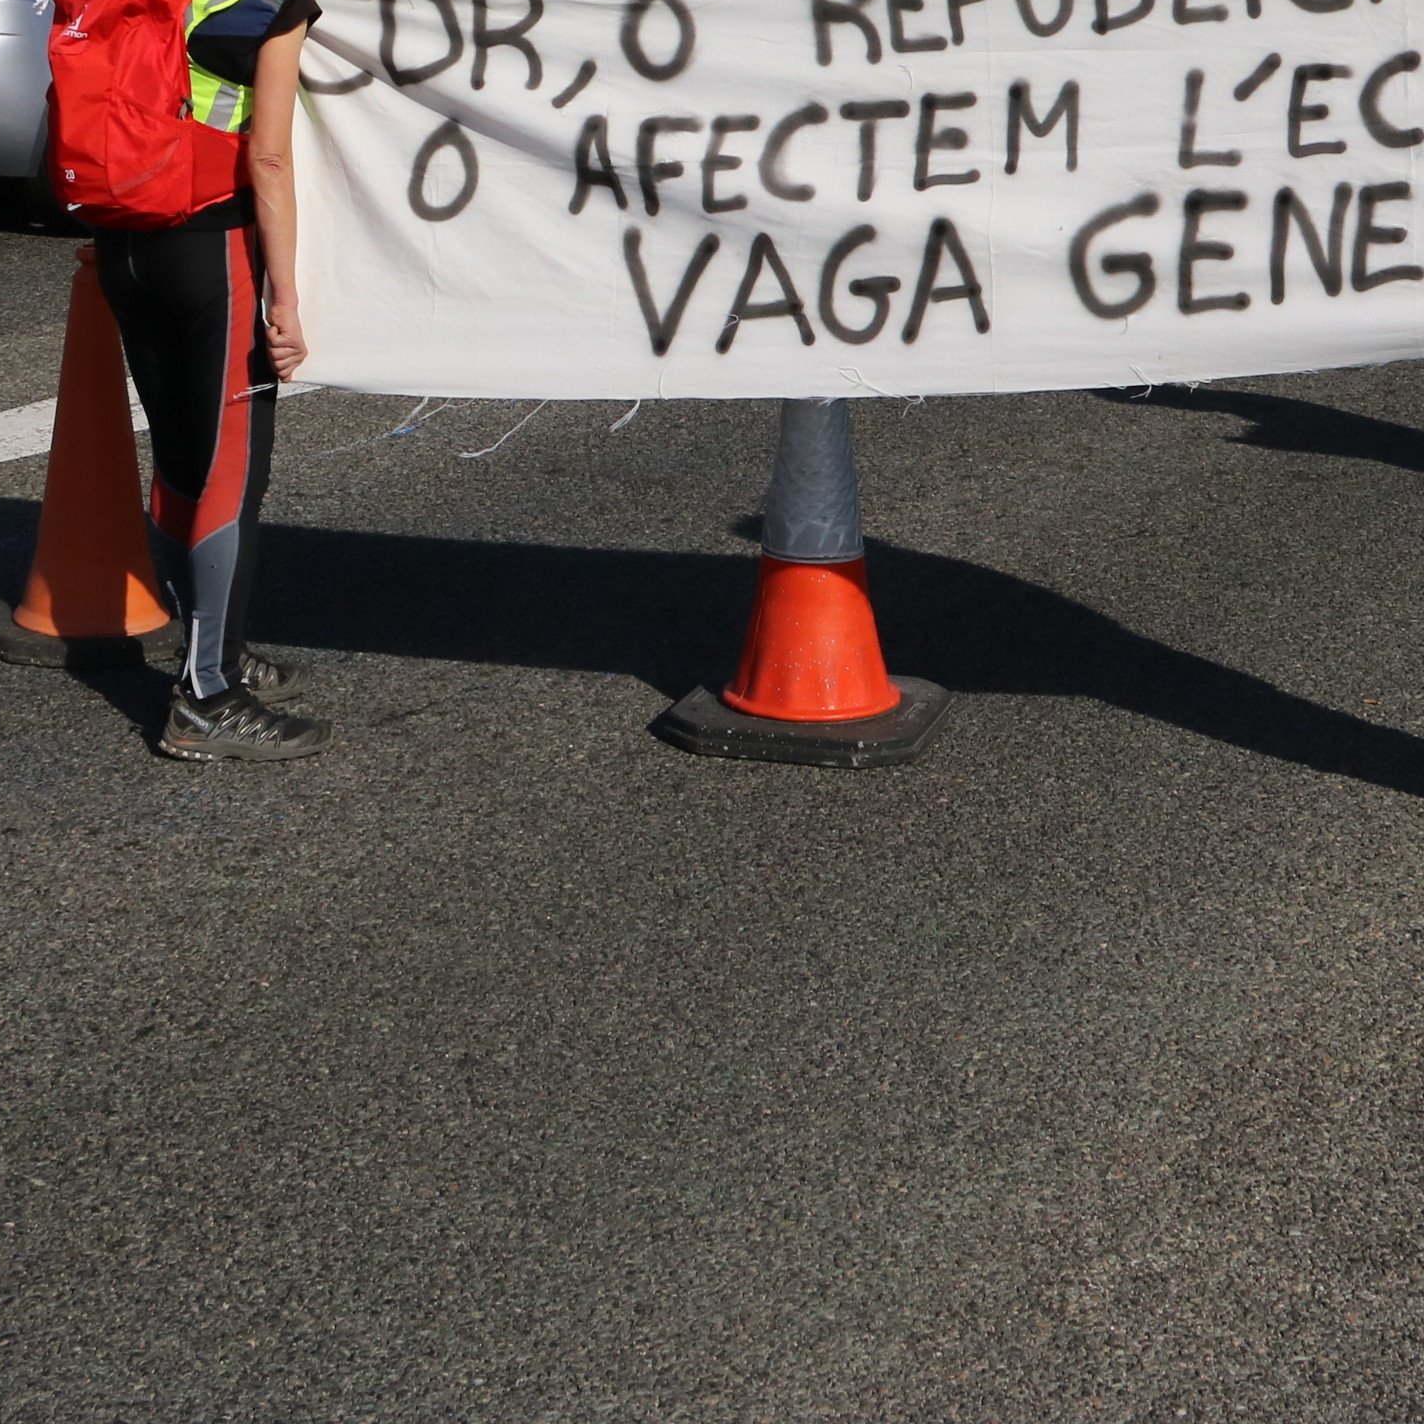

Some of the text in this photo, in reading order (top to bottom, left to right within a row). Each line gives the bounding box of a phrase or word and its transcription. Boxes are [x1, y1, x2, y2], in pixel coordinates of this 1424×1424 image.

[408, 118, 479, 222] O
[568, 79, 1080, 217] AFECTEM
[623, 216, 991, 357] VAGA
